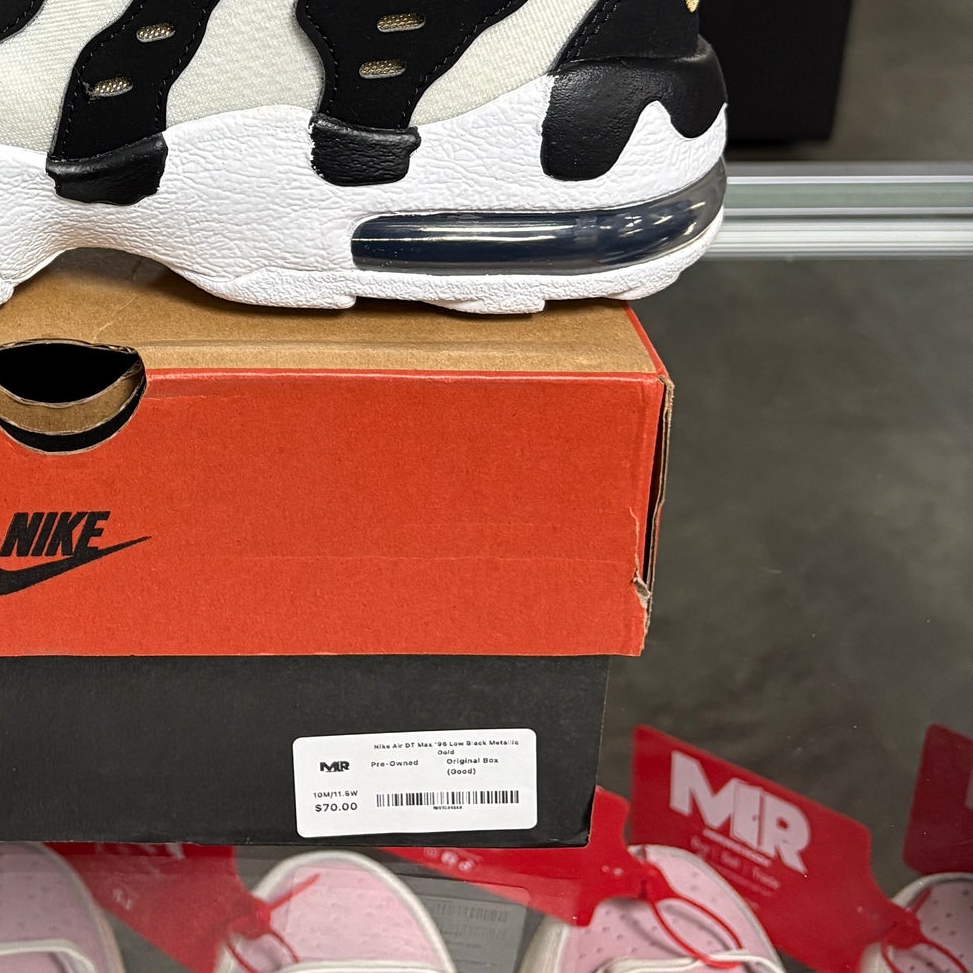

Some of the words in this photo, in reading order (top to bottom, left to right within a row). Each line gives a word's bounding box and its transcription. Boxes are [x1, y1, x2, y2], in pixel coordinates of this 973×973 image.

[371, 759, 419, 767] Pre-Owned
[446, 757, 480, 765] Original
[447, 768, 477, 776] (Good)
[313, 790, 358, 799] 10M/11.5W
[314, 802, 358, 812] $70.00
